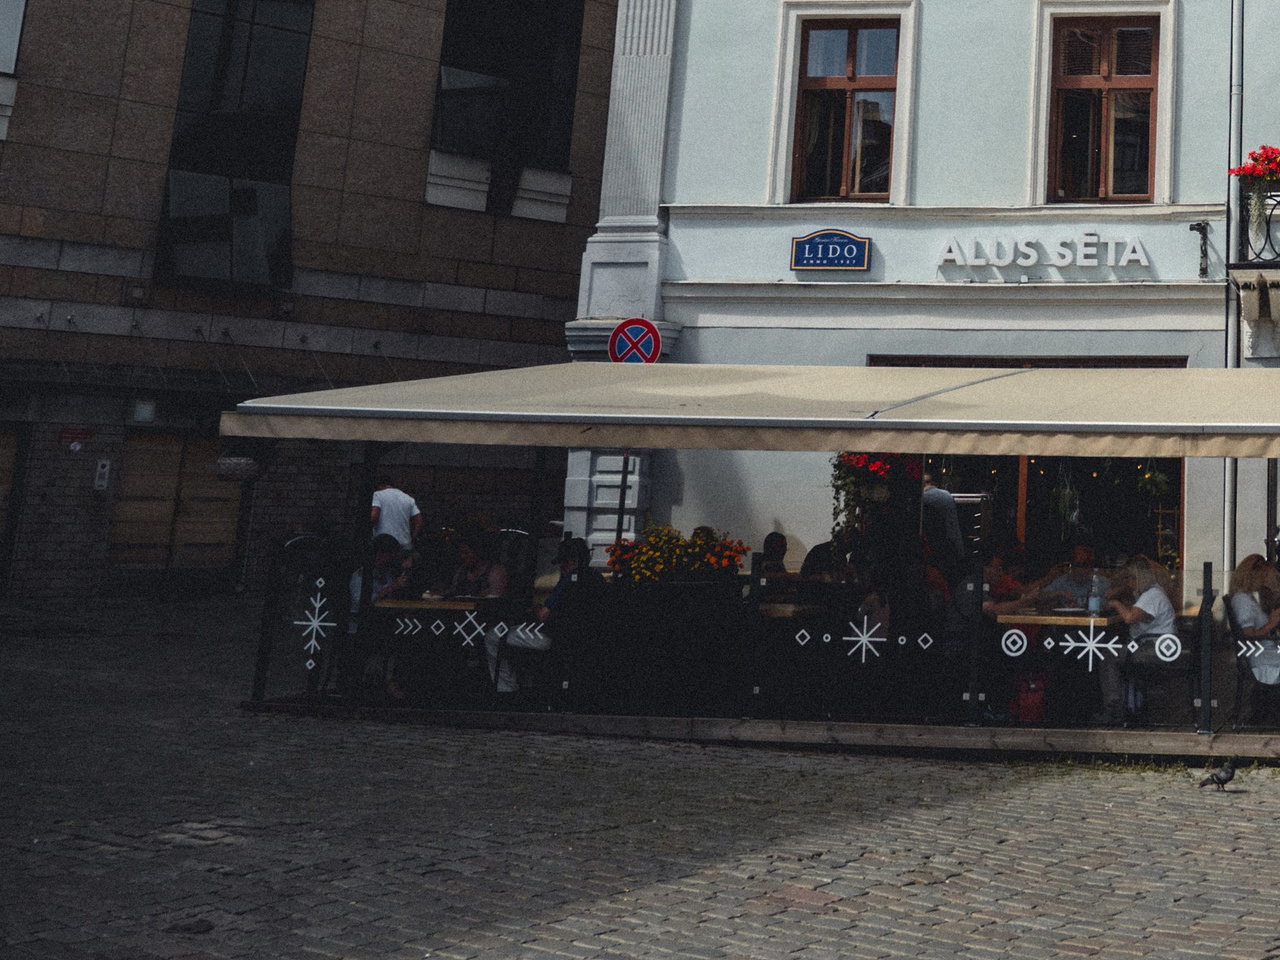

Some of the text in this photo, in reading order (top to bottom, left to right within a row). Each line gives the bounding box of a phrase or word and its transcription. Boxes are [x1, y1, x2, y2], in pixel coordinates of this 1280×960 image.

[804, 244, 857, 258] LIDO
[938, 231, 1149, 267] ALUS SĒTA
